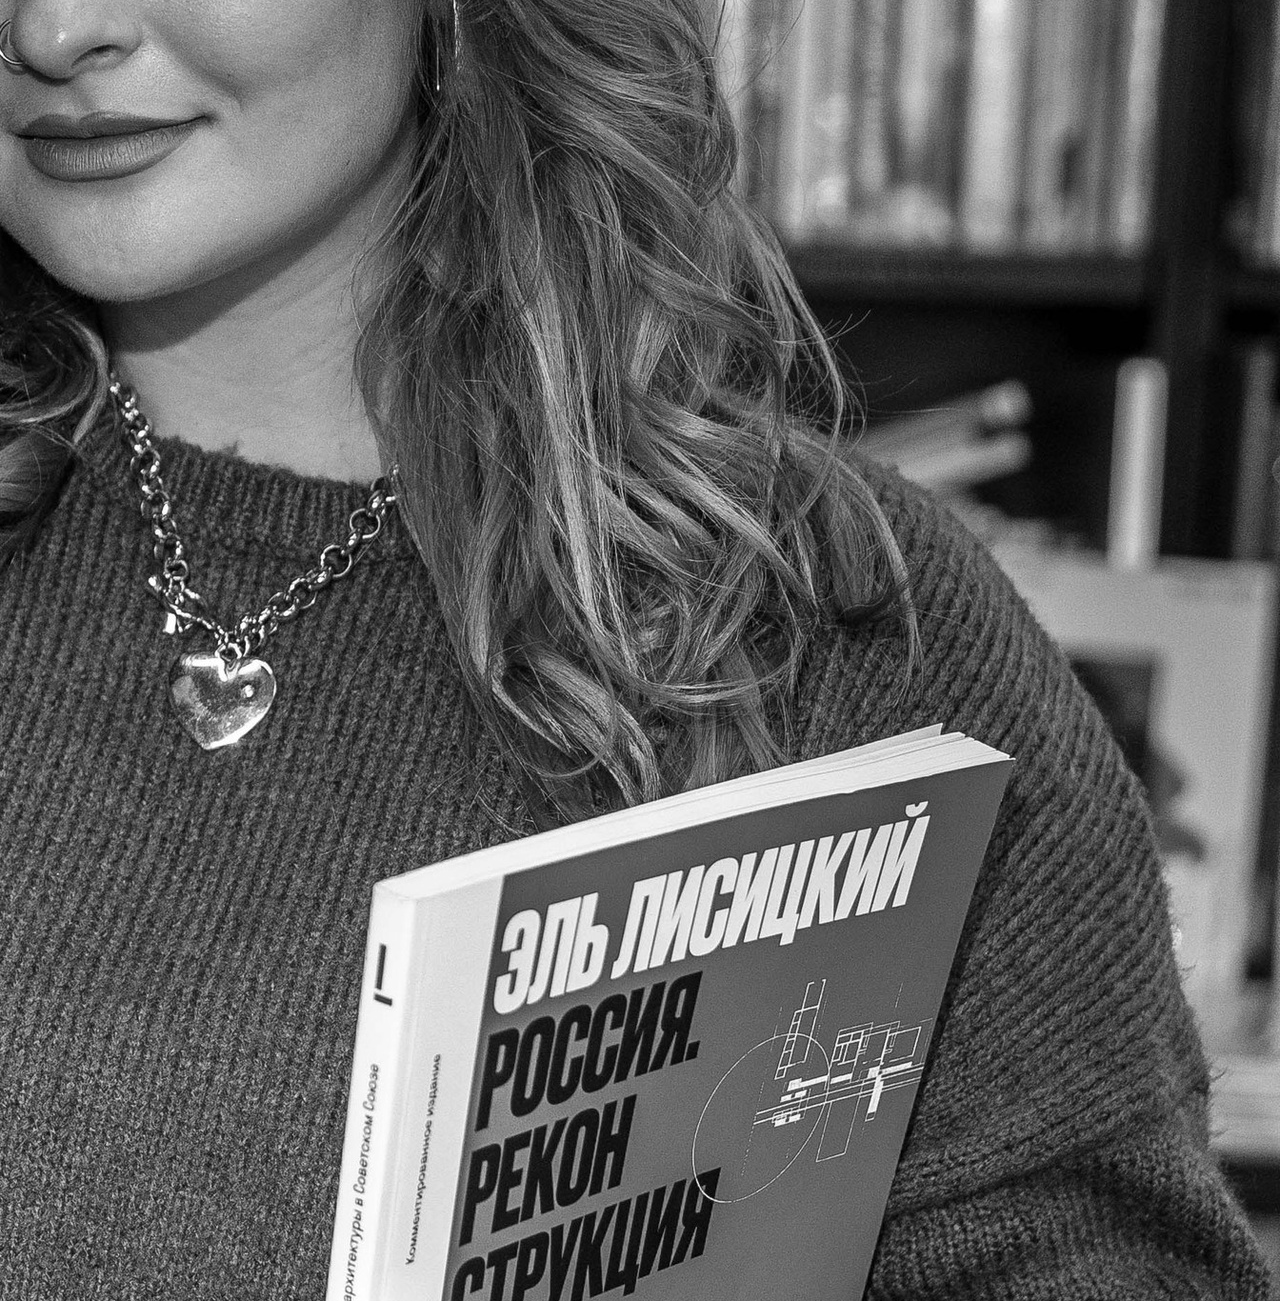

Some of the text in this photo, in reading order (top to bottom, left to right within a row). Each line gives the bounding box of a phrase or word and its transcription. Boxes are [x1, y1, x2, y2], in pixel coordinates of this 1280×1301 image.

[494, 801, 930, 1015] ЭЛЬ ЛИСИЦКИЙ
[362, 1063, 379, 1111] Союзе
[475, 970, 703, 1132] РОССИЯ.
[352, 1117, 373, 1194] Советском
[355, 1197, 364, 1207] в
[406, 1054, 441, 1265] Комментированное издание
[459, 1094, 637, 1247] РЕКОН
